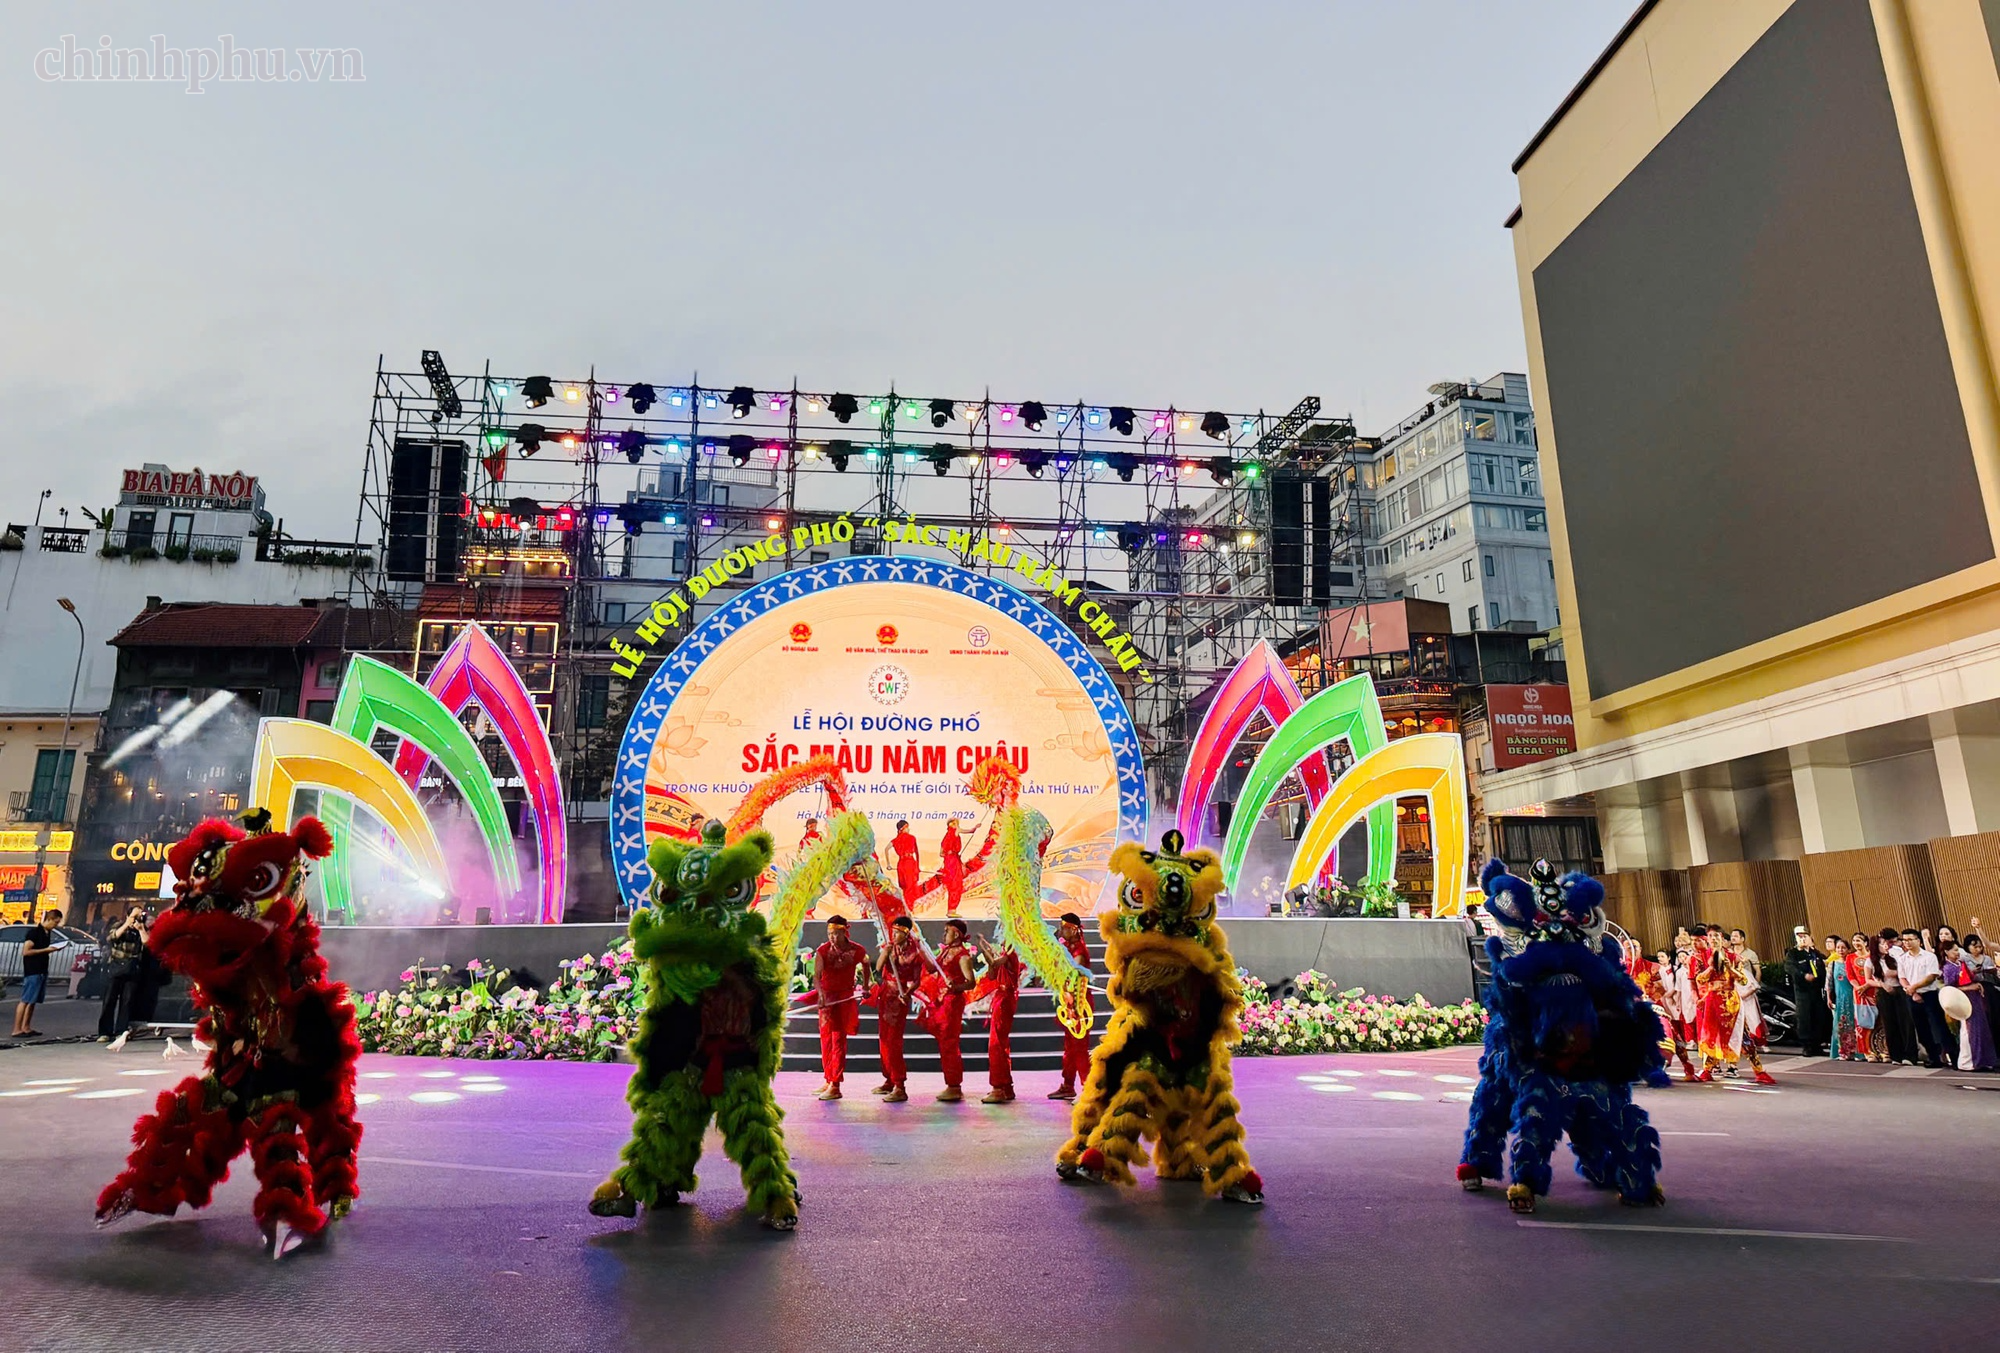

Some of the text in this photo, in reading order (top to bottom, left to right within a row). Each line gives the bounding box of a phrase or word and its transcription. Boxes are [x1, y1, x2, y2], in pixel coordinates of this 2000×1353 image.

[121, 467, 257, 506] BIA HÀ NỘI
[610, 637, 647, 680] LỄ
[635, 592, 690, 646] HỘI
[686, 534, 788, 599] ĐƯỜNG
[792, 511, 855, 550] PHỐ
[946, 528, 1011, 567] MÀU
[1014, 554, 1083, 607] NĂM
[878, 682, 901, 694] CWF
[793, 708, 980, 735] LỄ HỘI ĐƯỜNG PHỐ
[1494, 714, 1573, 726] NGỌC HOA
[1540, 736, 1567, 745] DÍNH
[741, 733, 799, 774] SẮC
[882, 739, 946, 774] NĂM
[1508, 747, 1544, 755] DECAL
[665, 783, 708, 793] TRONG
[870, 780, 897, 794] HÓA
[901, 780, 922, 794] THẾ
[925, 781, 951, 794] GIỚI
[1047, 782, 1070, 794] THỨ
[911, 811, 923, 819] 10
[925, 811, 948, 819] năm
[951, 811, 975, 819] 2026
[0, 872, 26, 885] MAR
[97, 882, 114, 893] 116
